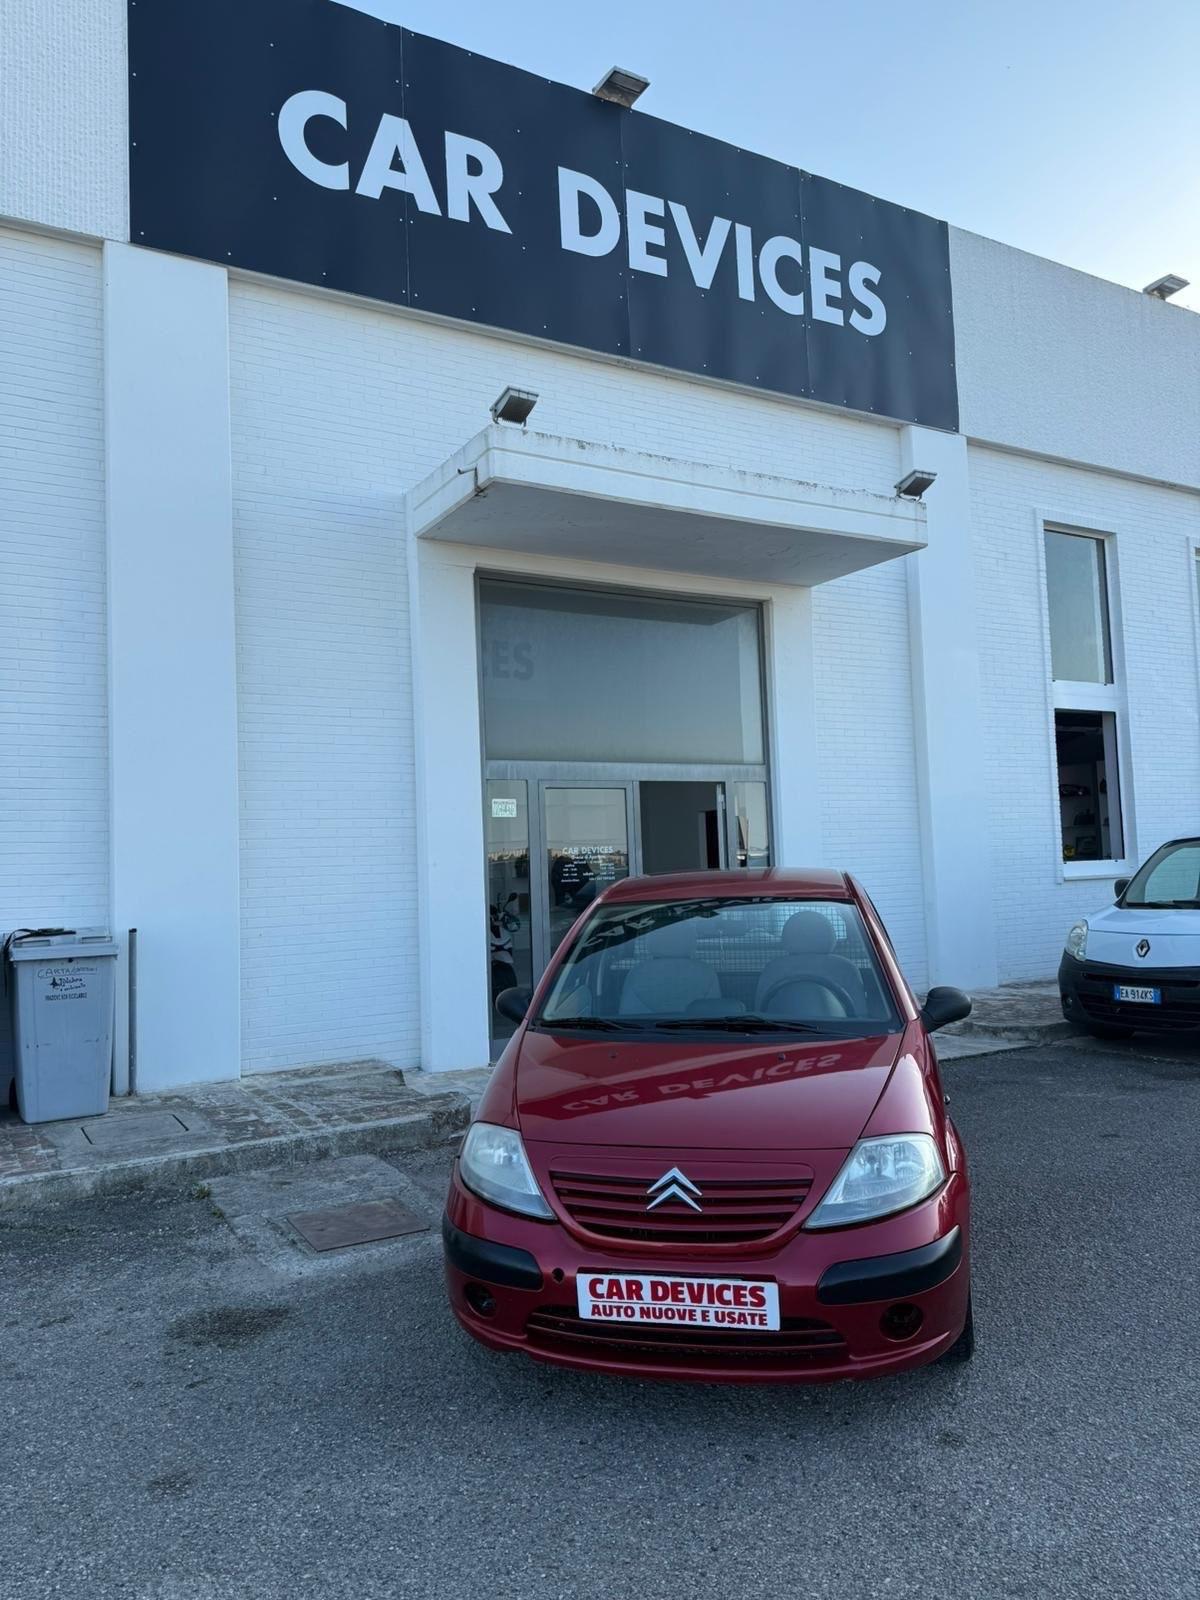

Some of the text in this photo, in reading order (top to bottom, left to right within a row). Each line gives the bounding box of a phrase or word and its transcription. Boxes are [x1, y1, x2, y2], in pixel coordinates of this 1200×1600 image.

[278, 90, 887, 337] CAR DEVICES
[483, 640, 534, 681] ES
[562, 845, 614, 855] CAR DEVICES
[1120, 988, 1130, 999] EA
[588, 1278, 767, 1308] CAR DEVICES
[591, 1304, 768, 1326] AUTO NUOVE E USATE
